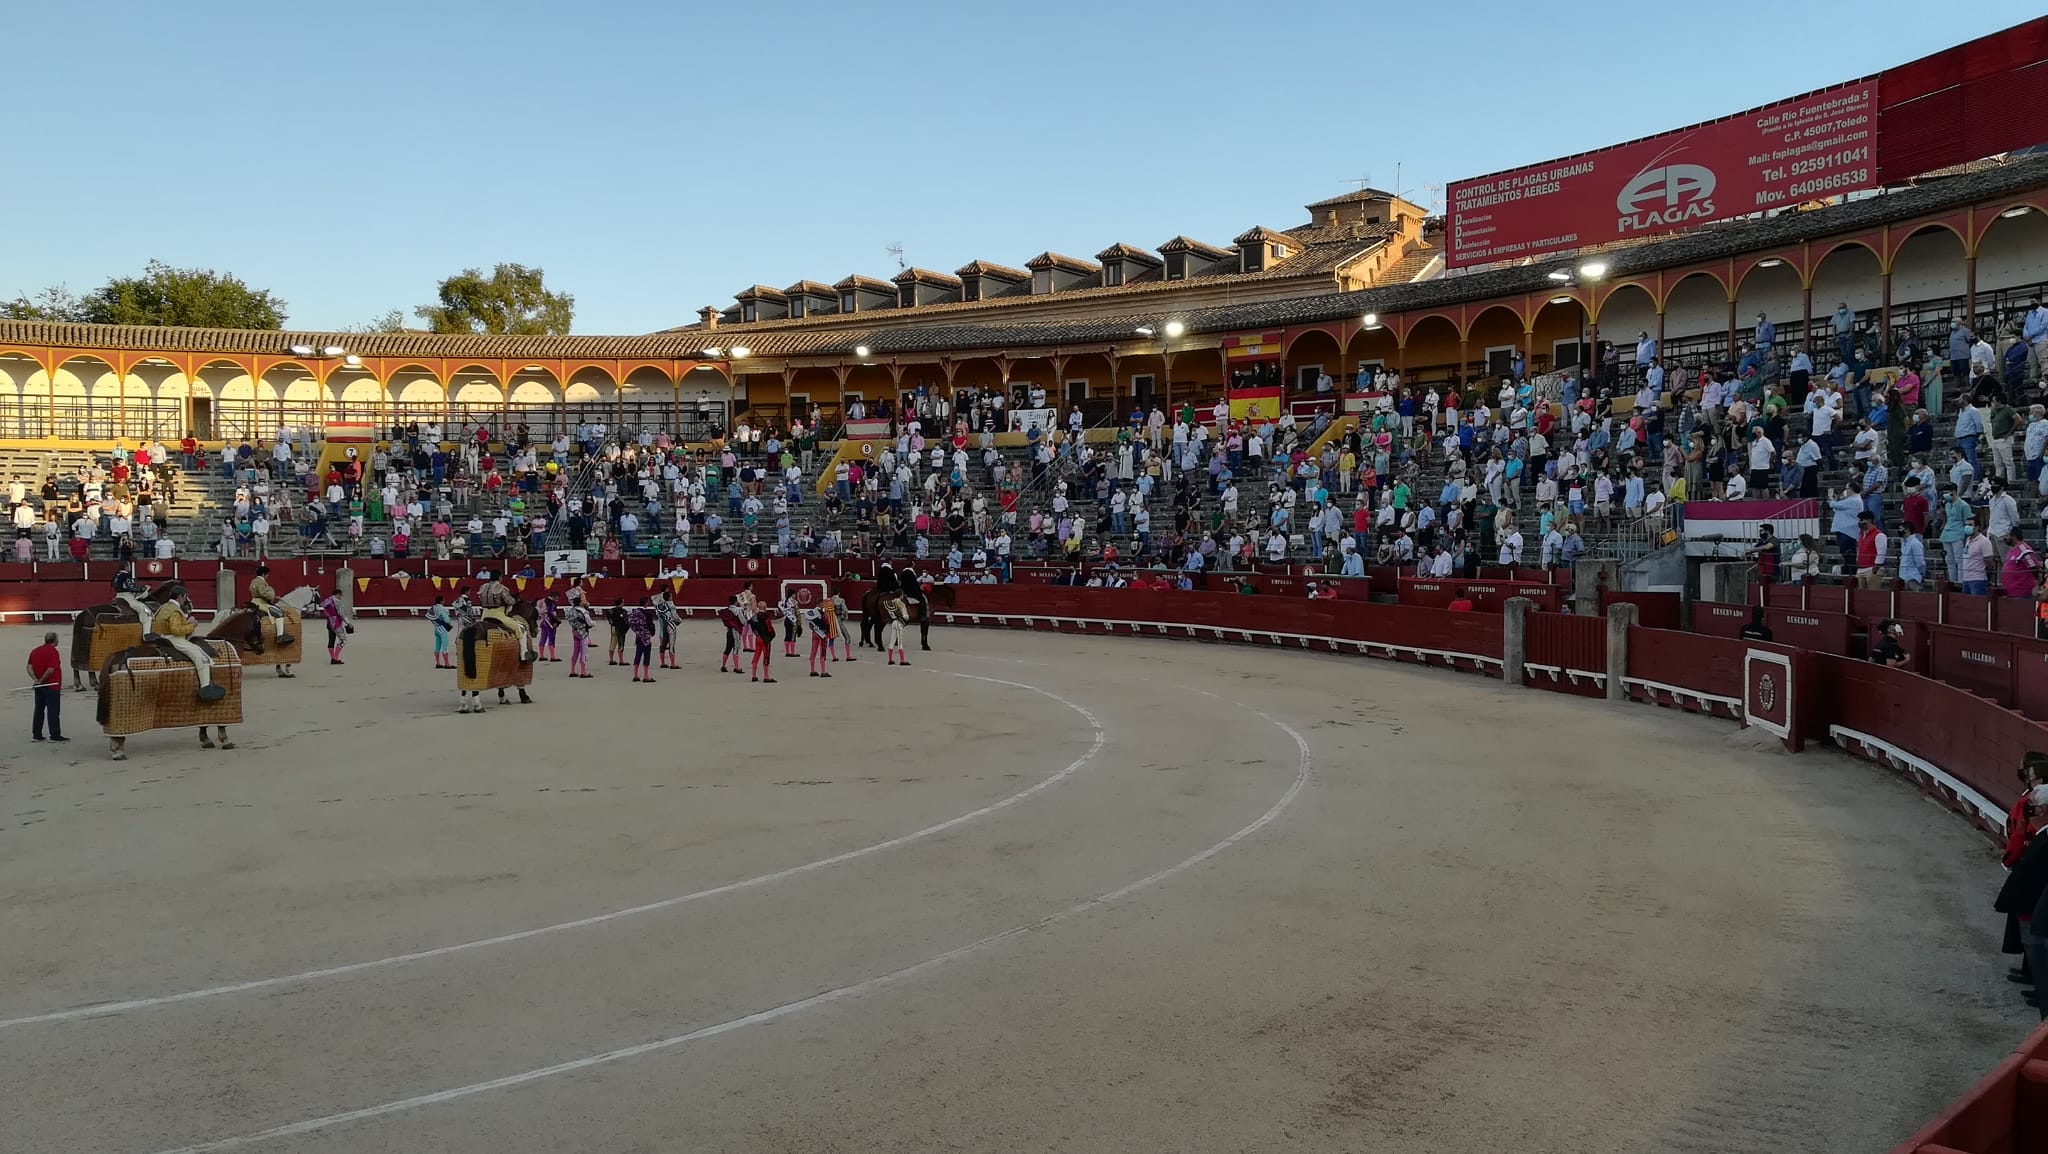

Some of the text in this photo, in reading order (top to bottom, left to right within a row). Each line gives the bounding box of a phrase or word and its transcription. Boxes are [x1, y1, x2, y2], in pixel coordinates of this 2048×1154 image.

[1757, 116, 1779, 128] Calle
[1800, 94, 1860, 117] Fuentebrada
[1862, 90, 1869, 100] 5
[1748, 130, 1868, 166] Mail: faplagas@gmail.com
[1785, 131, 1801, 142] C.P.
[1762, 146, 1868, 182] Tel. 925911041
[1456, 161, 1594, 200] CONTROL DE PLAGAS URBANAS
[1456, 181, 1560, 212] TRATAMIENTOS AEREOS
[1756, 168, 1868, 204] Mov. 640966538
[1618, 199, 1715, 232] PLAGAS
[1456, 233, 1578, 261] SERVICIOS A EMPRESAS Y PARTICULARES
[1467, 585, 1496, 593] PROPIEDAD
[1712, 607, 1744, 617] RESERVADO
[1786, 615, 1819, 626] RESERVADO
